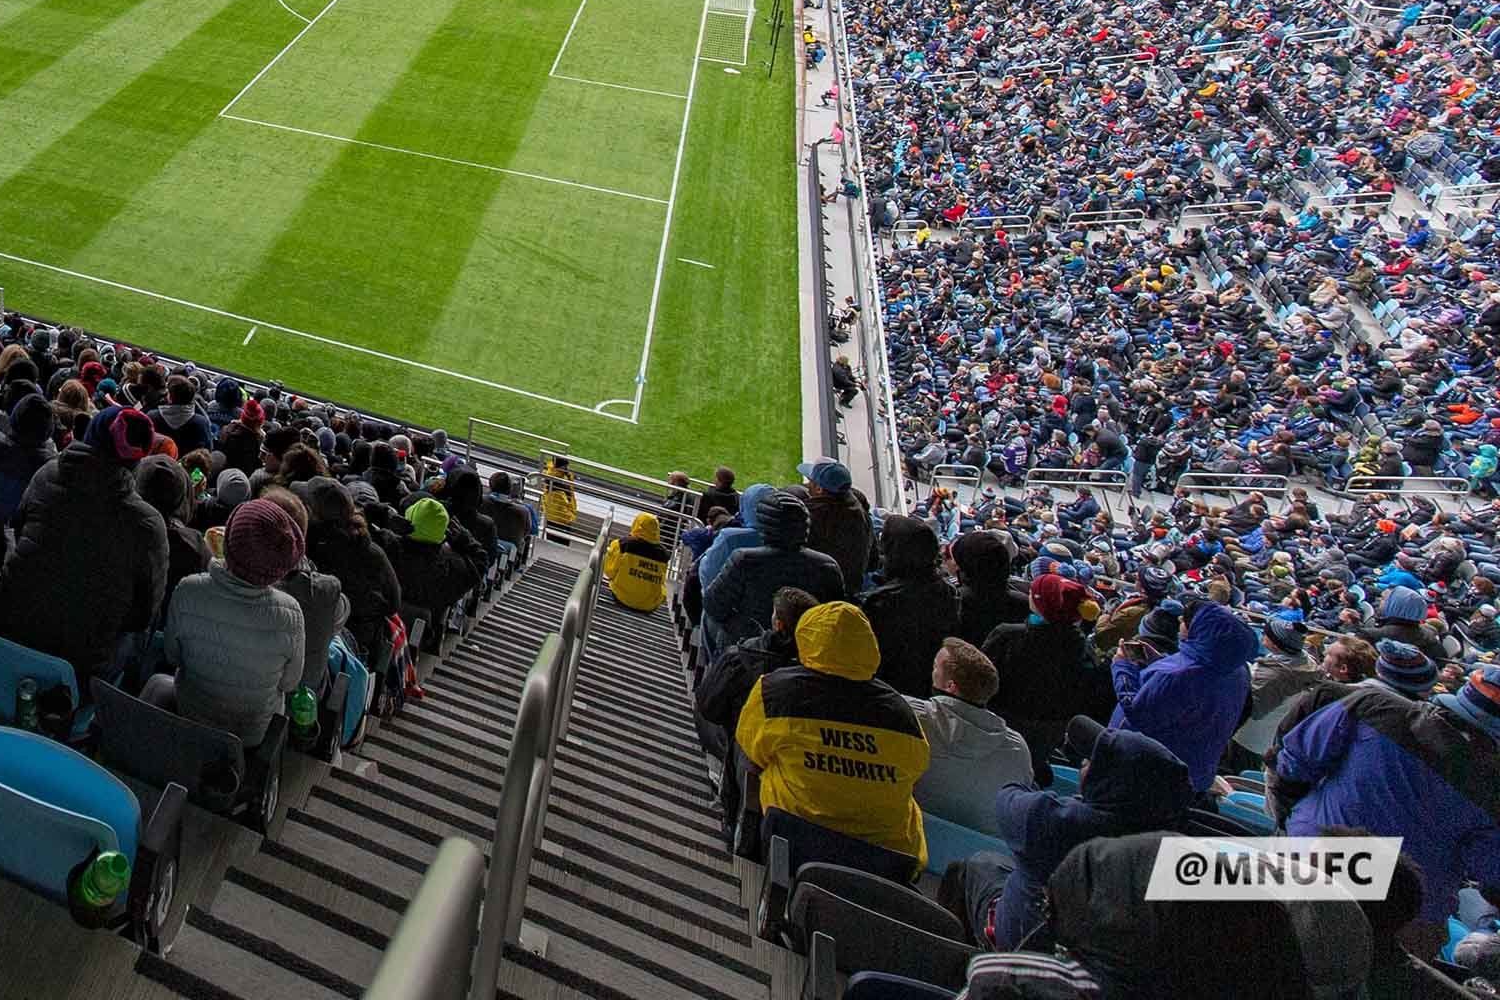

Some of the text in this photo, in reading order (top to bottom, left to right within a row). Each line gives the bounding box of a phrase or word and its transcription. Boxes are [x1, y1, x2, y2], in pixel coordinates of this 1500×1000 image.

[628, 568, 662, 584] SECURITY
[820, 728, 878, 755] WESS
[803, 751, 897, 783] SECURITY
